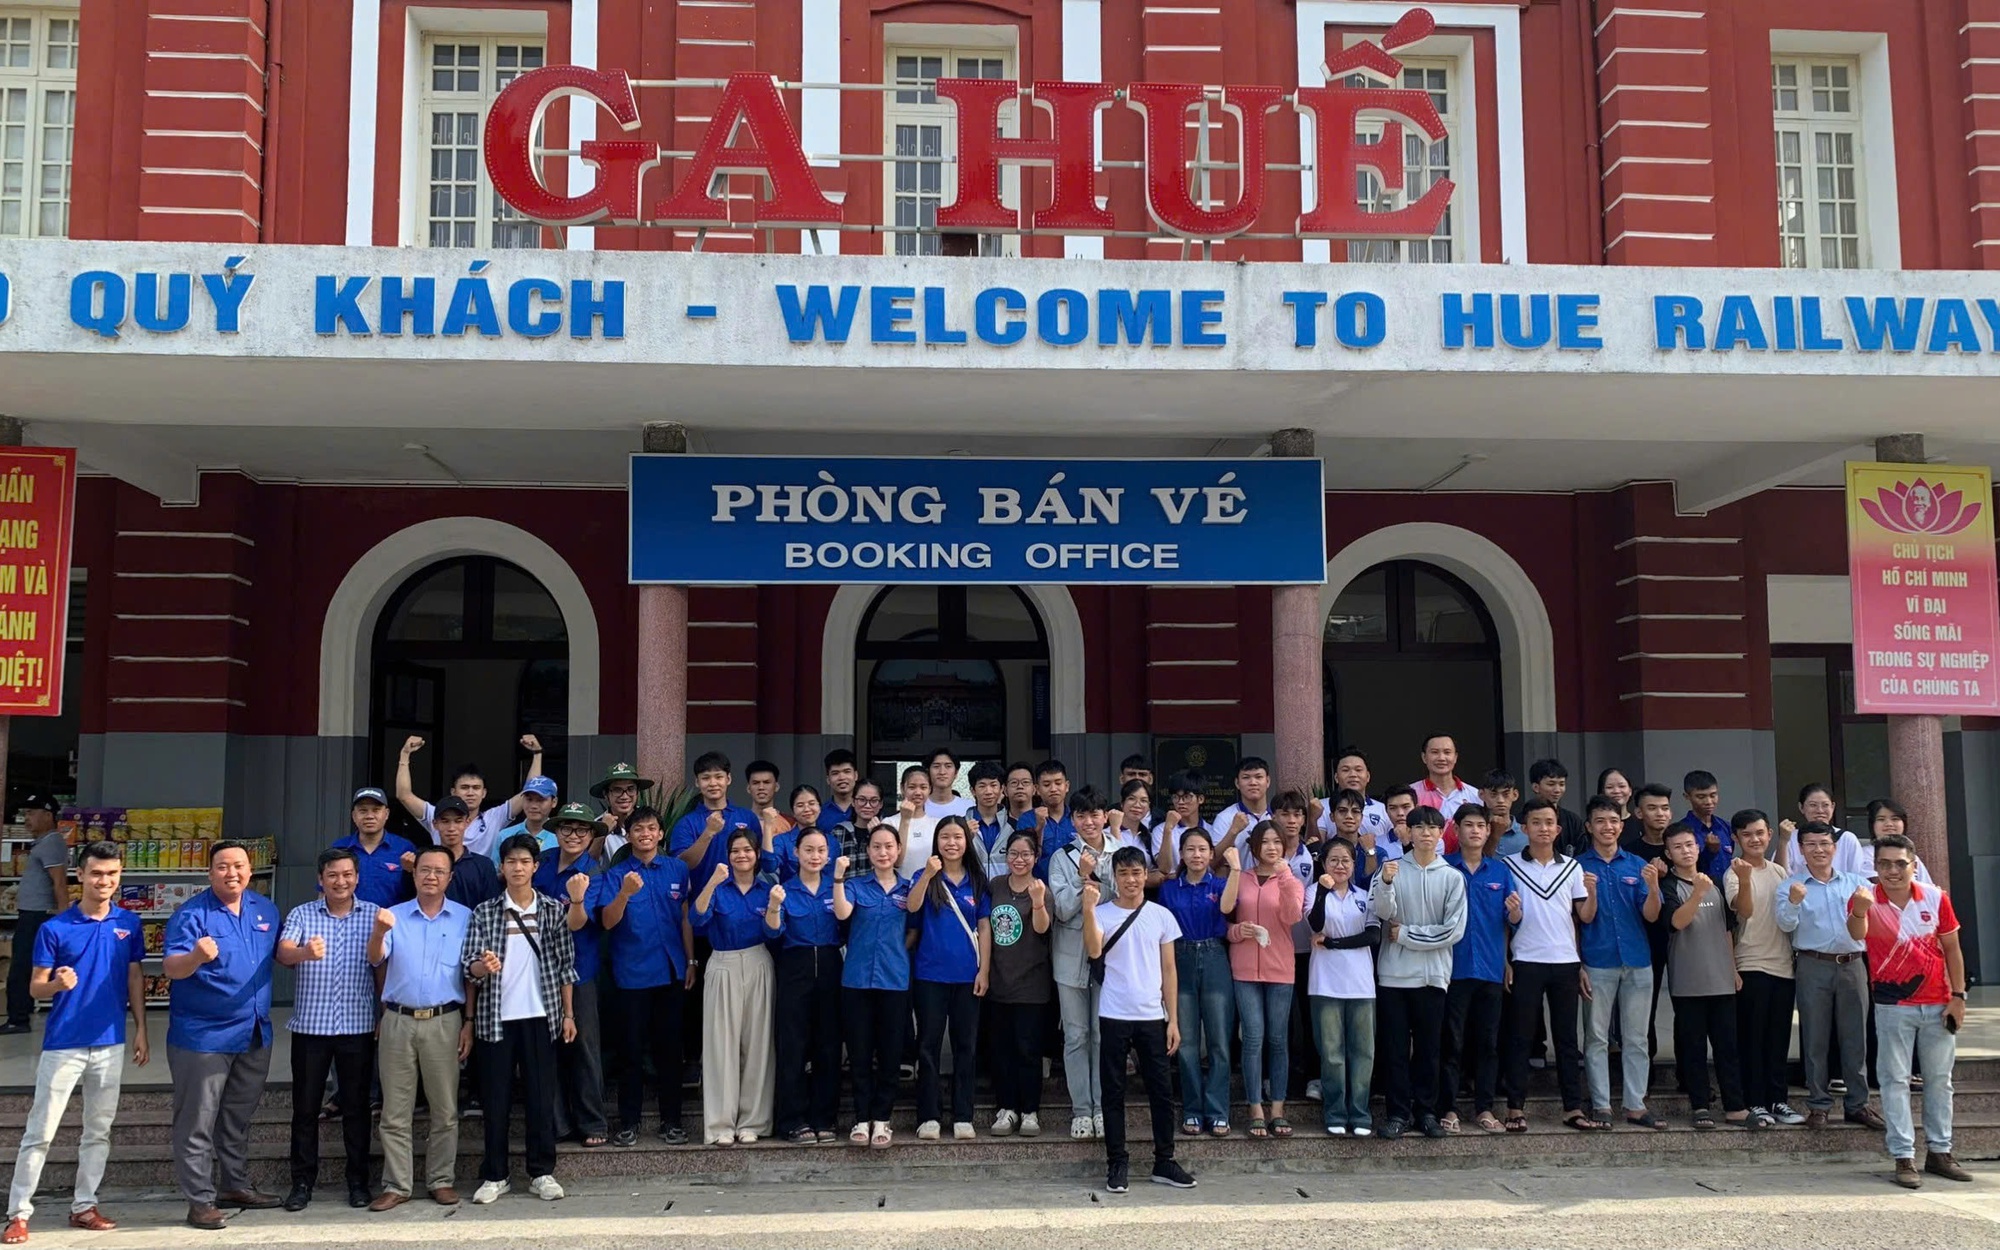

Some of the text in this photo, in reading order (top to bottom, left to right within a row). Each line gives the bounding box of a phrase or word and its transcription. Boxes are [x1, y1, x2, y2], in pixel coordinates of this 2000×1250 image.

[483, 8, 1456, 240] GA HUẾ
[69, 256, 256, 338] QUÝ
[314, 260, 625, 339] KHÁCH
[775, 284, 1228, 348] WELCOME
[1283, 291, 1388, 350] TO
[1442, 292, 1604, 350] HUE
[711, 470, 1249, 525] PHÒNG BÁN VÉ
[784, 541, 1180, 570] BOOKING OFFICE
[1893, 539, 1955, 563] CHỦ TỊCH
[24, 559, 49, 596] VÀ
[1882, 565, 1968, 588] HỒ CHÍ MINH
[1906, 594, 1947, 617] VĨ ĐẠI
[1893, 620, 1962, 642] SỐNG MÃI
[1868, 650, 1990, 672] TRONG SỰ NGHIỆP
[1880, 673, 1980, 696] CỦA CHÚNG TA
